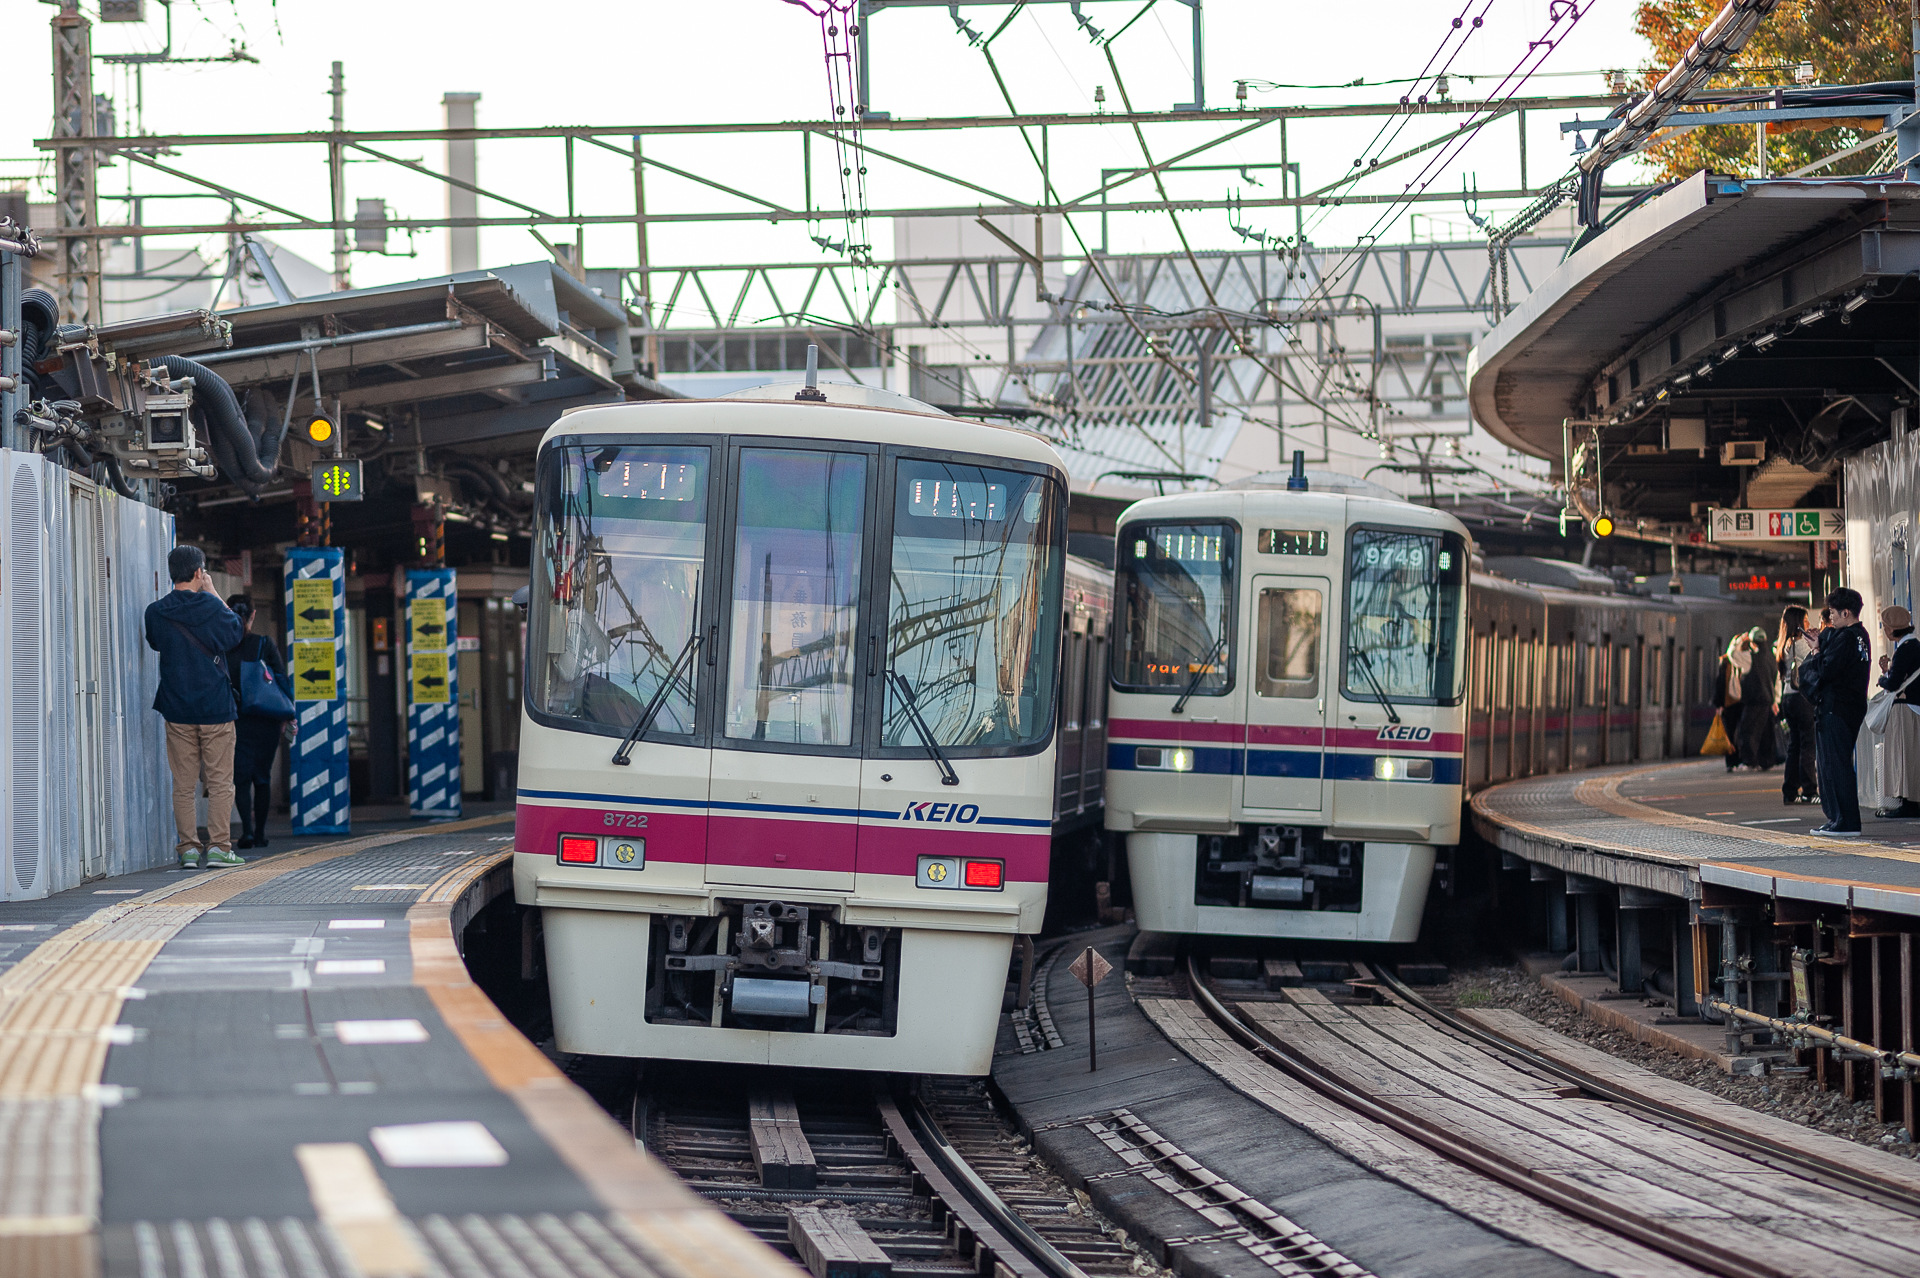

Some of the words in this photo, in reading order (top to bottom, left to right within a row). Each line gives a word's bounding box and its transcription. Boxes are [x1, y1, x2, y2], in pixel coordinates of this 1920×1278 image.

[1366, 547, 1423, 567] 9749
[1379, 725, 1431, 740] KEIO
[603, 812, 648, 828] 8722
[902, 801, 979, 823] KEIO
